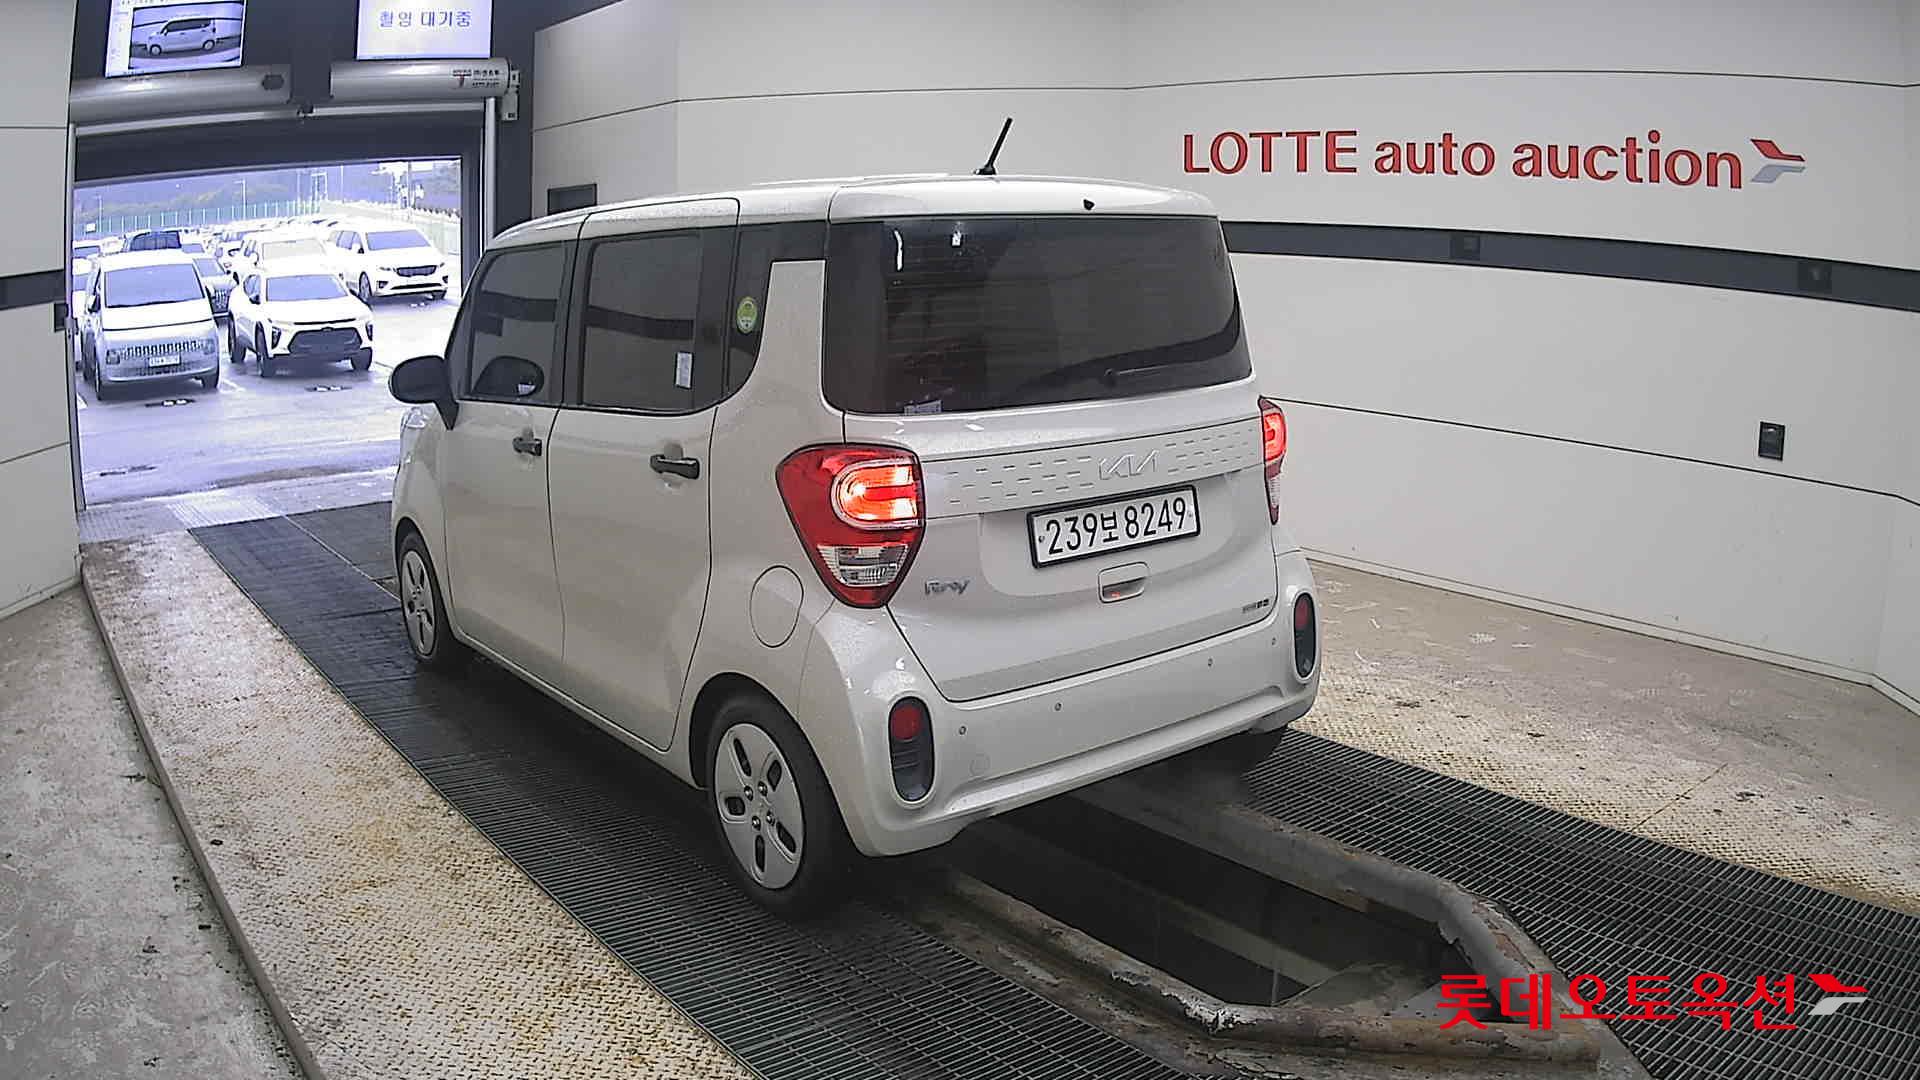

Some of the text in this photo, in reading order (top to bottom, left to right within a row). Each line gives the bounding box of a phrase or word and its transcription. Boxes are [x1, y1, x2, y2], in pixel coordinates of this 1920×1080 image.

[421, 11, 472, 27] 대기중
[1183, 129, 1742, 189] LOTTE auto auction
